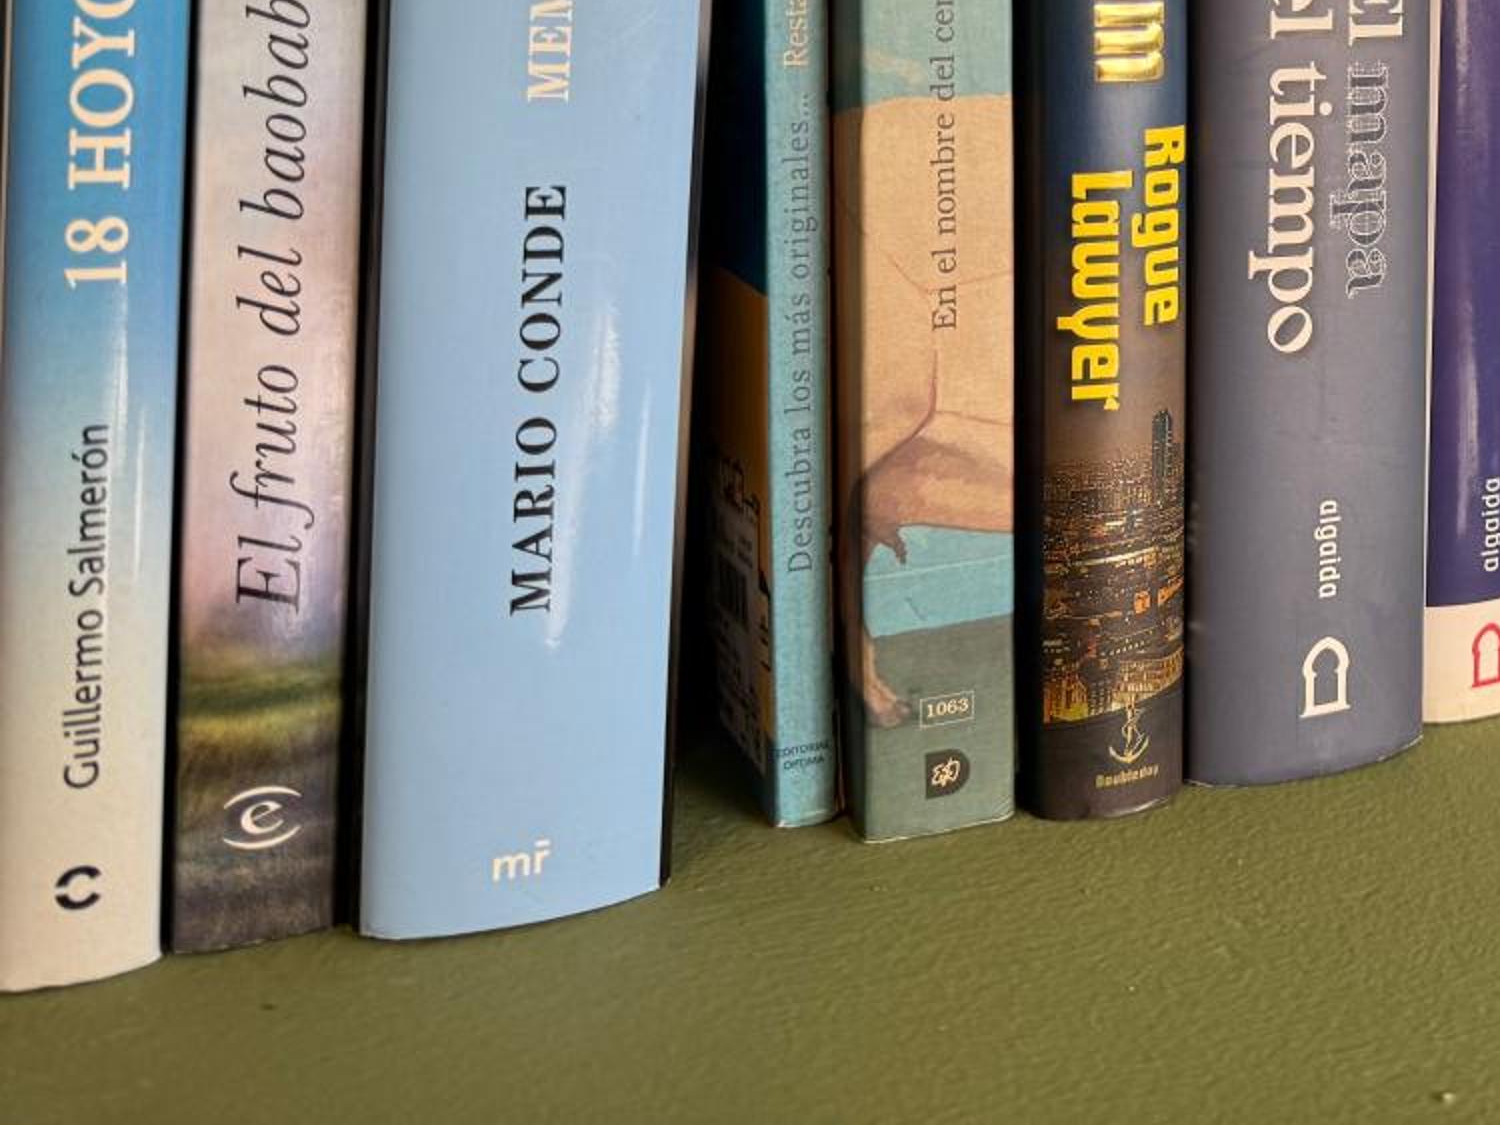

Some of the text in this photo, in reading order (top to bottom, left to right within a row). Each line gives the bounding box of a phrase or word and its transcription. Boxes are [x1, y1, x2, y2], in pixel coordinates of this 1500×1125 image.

[930, 55, 955, 102] del
[782, 92, 818, 279] originales...
[930, 113, 957, 236] nombre
[1132, 124, 1185, 326] Rogue
[1248, 61, 1331, 355] tiempo
[1330, 62, 1390, 299] mapa
[65, 215, 128, 289] 18
[237, 248, 302, 338] del
[932, 250, 957, 274] el
[1056, 170, 1132, 411] Lawyer
[785, 293, 811, 355] más
[933, 286, 957, 331] En
[229, 361, 316, 530] fruto
[509, 184, 566, 616] MARIO CONDE
[784, 369, 811, 411] los
[785, 428, 813, 573] Descubra
[1314, 499, 1338, 599] algaida
[62, 422, 108, 789] Guillermo Salmerón
[234, 535, 301, 615] El
[926, 698, 969, 718] 1063
